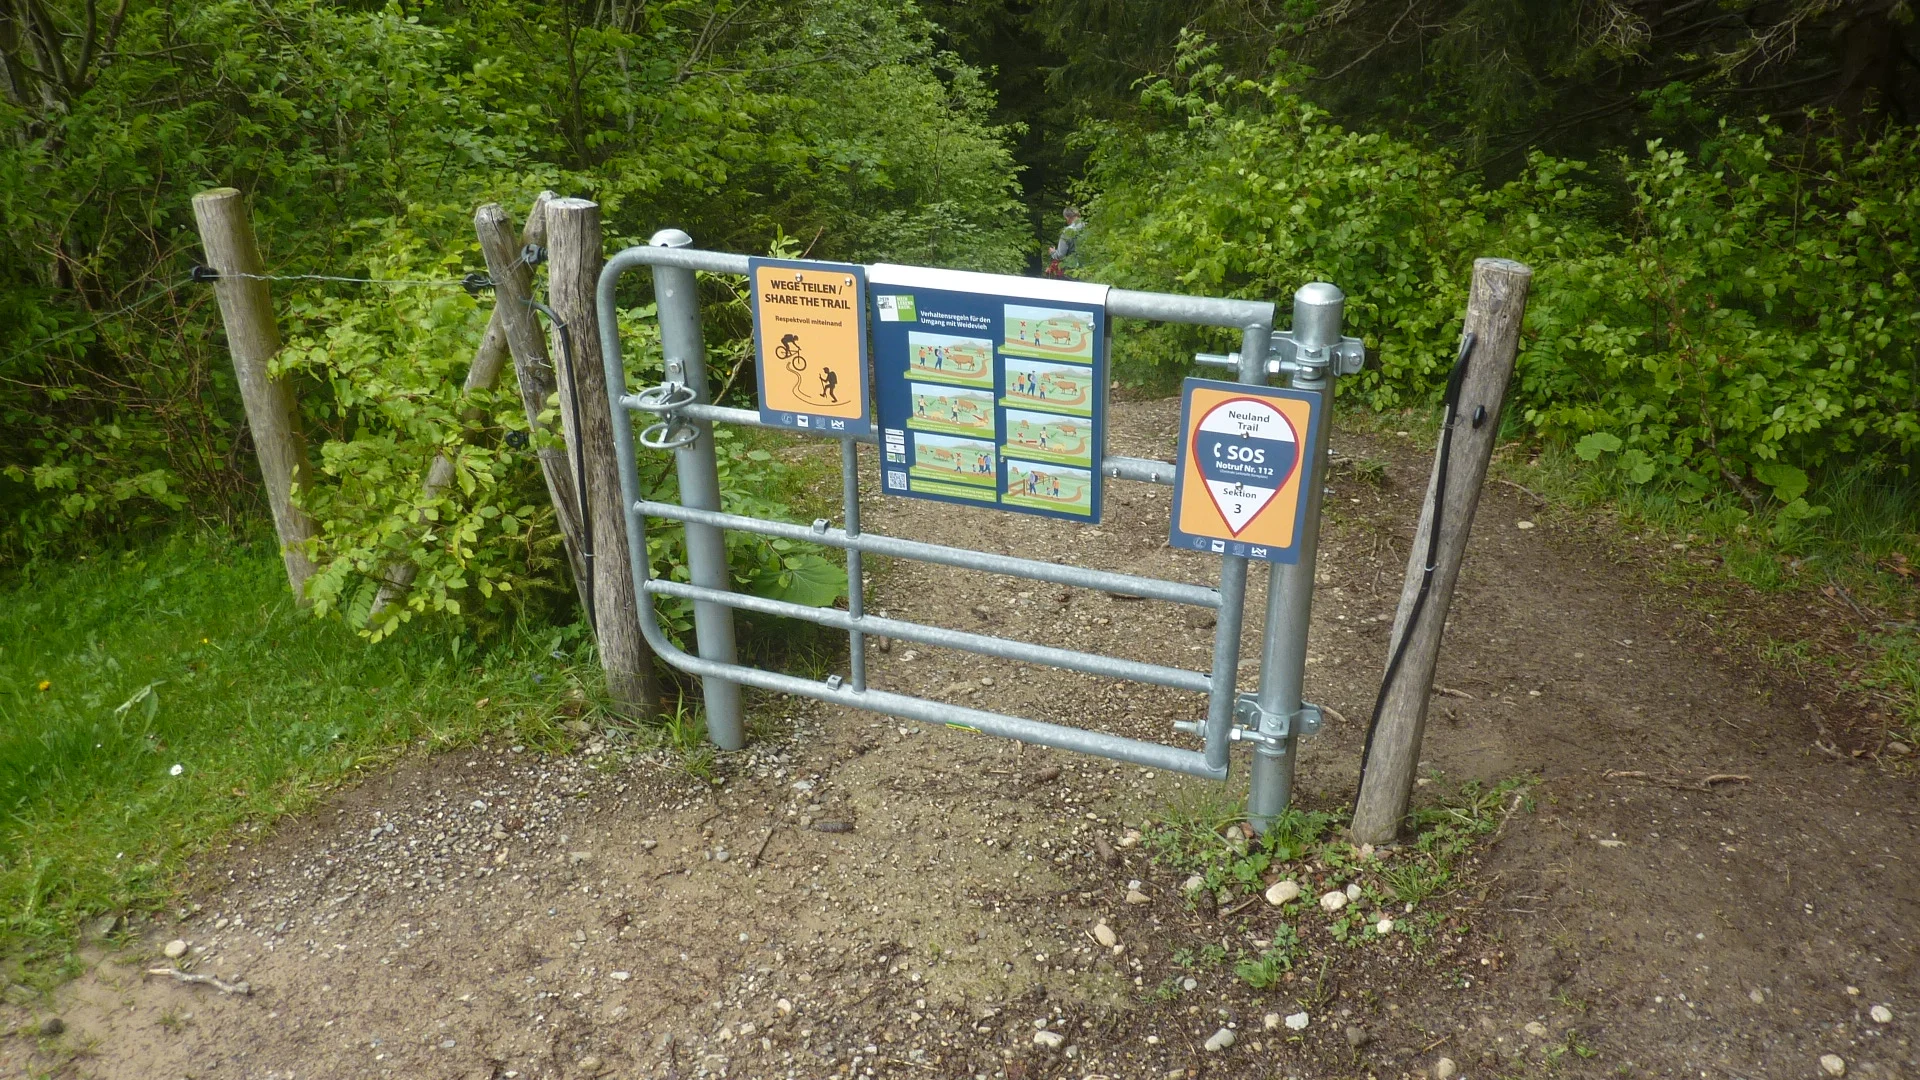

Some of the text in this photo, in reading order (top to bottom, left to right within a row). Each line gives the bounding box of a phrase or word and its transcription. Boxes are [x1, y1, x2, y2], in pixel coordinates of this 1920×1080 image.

[771, 280, 842, 295] WEGE TEILEN /
[765, 294, 851, 310] SHARE THE TRAIL
[775, 315, 843, 327] Respektvoll miteinand
[920, 311, 969, 321] Verhaltensregeln
[921, 318, 946, 327] Umgang
[957, 322, 988, 330] Weidevieh
[1228, 410, 1270, 423] Neuland
[1238, 422, 1259, 432] Trail
[1227, 445, 1265, 463] SOS
[1216, 461, 1243, 472] Notruf
[1244, 464, 1257, 474] Nr.
[1258, 467, 1274, 476] 112
[1223, 487, 1257, 499] Sektion
[1233, 503, 1242, 514] 3
